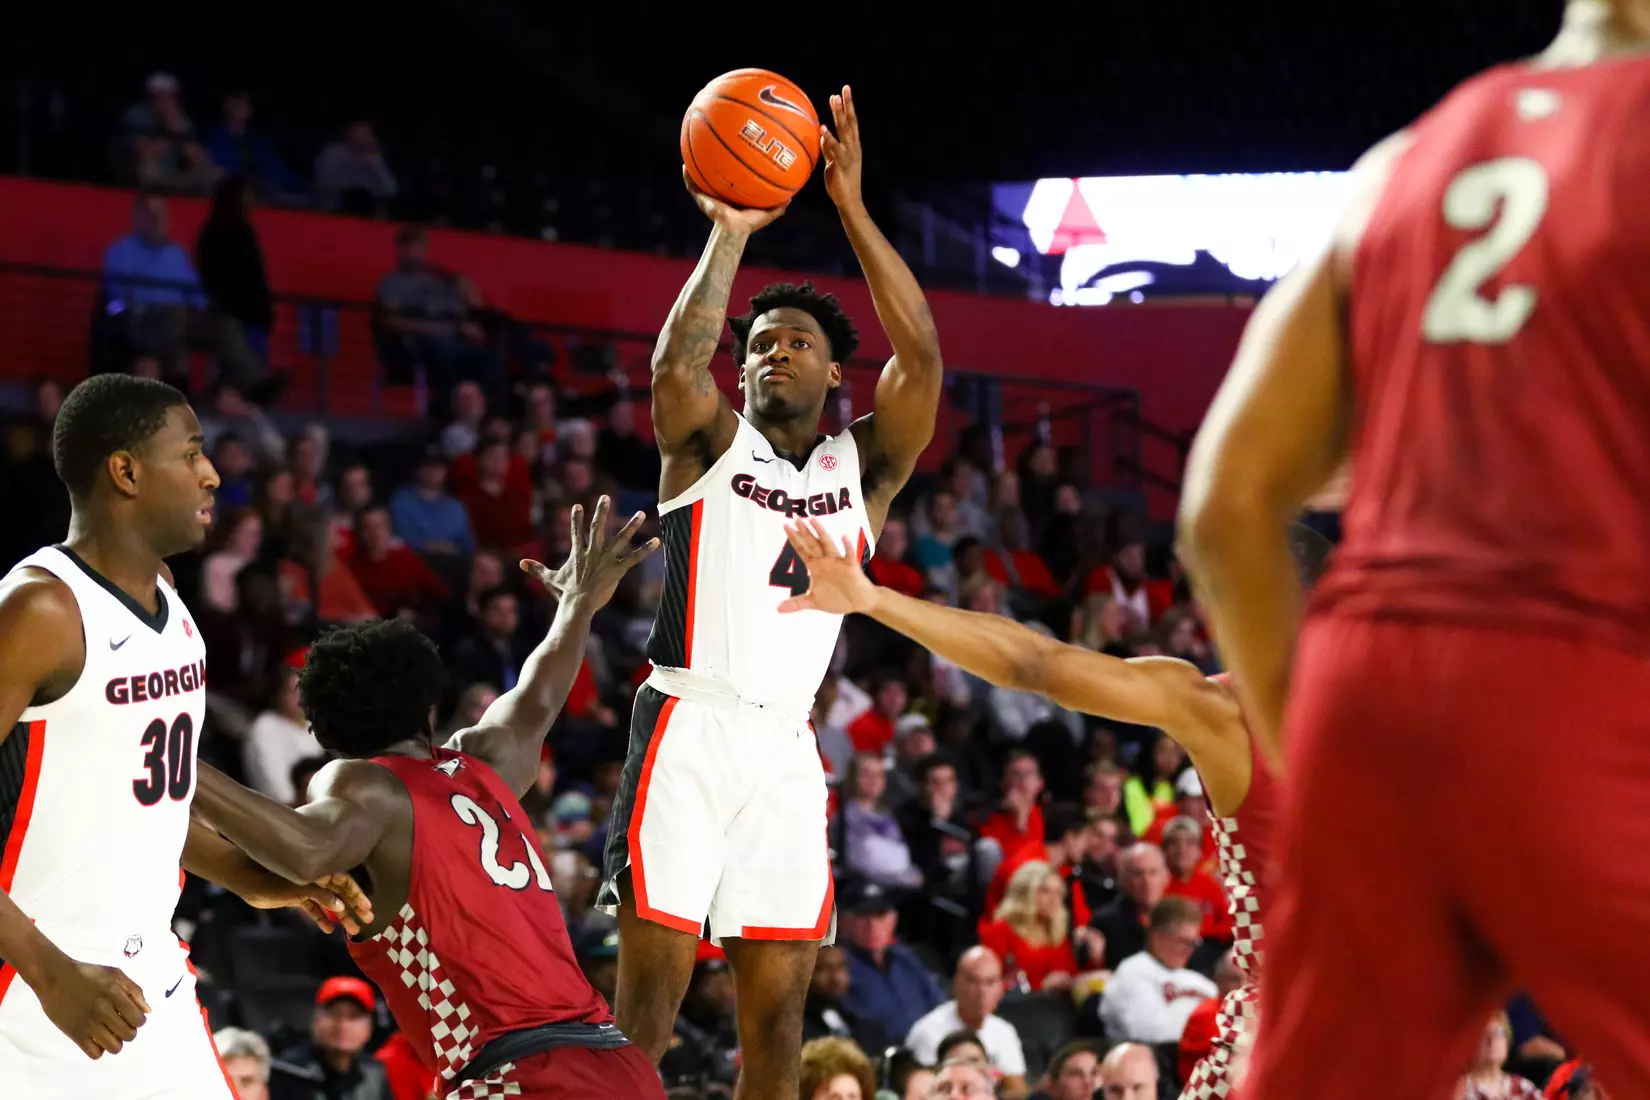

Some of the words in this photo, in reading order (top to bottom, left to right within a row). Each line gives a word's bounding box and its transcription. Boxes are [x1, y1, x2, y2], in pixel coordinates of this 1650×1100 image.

[740, 119, 797, 171] ELITE
[1421, 155, 1548, 345] 2
[820, 455, 837, 470] SEC
[731, 473, 852, 518] GEORGIA
[769, 537, 811, 597] 4
[132, 712, 193, 806] 30
